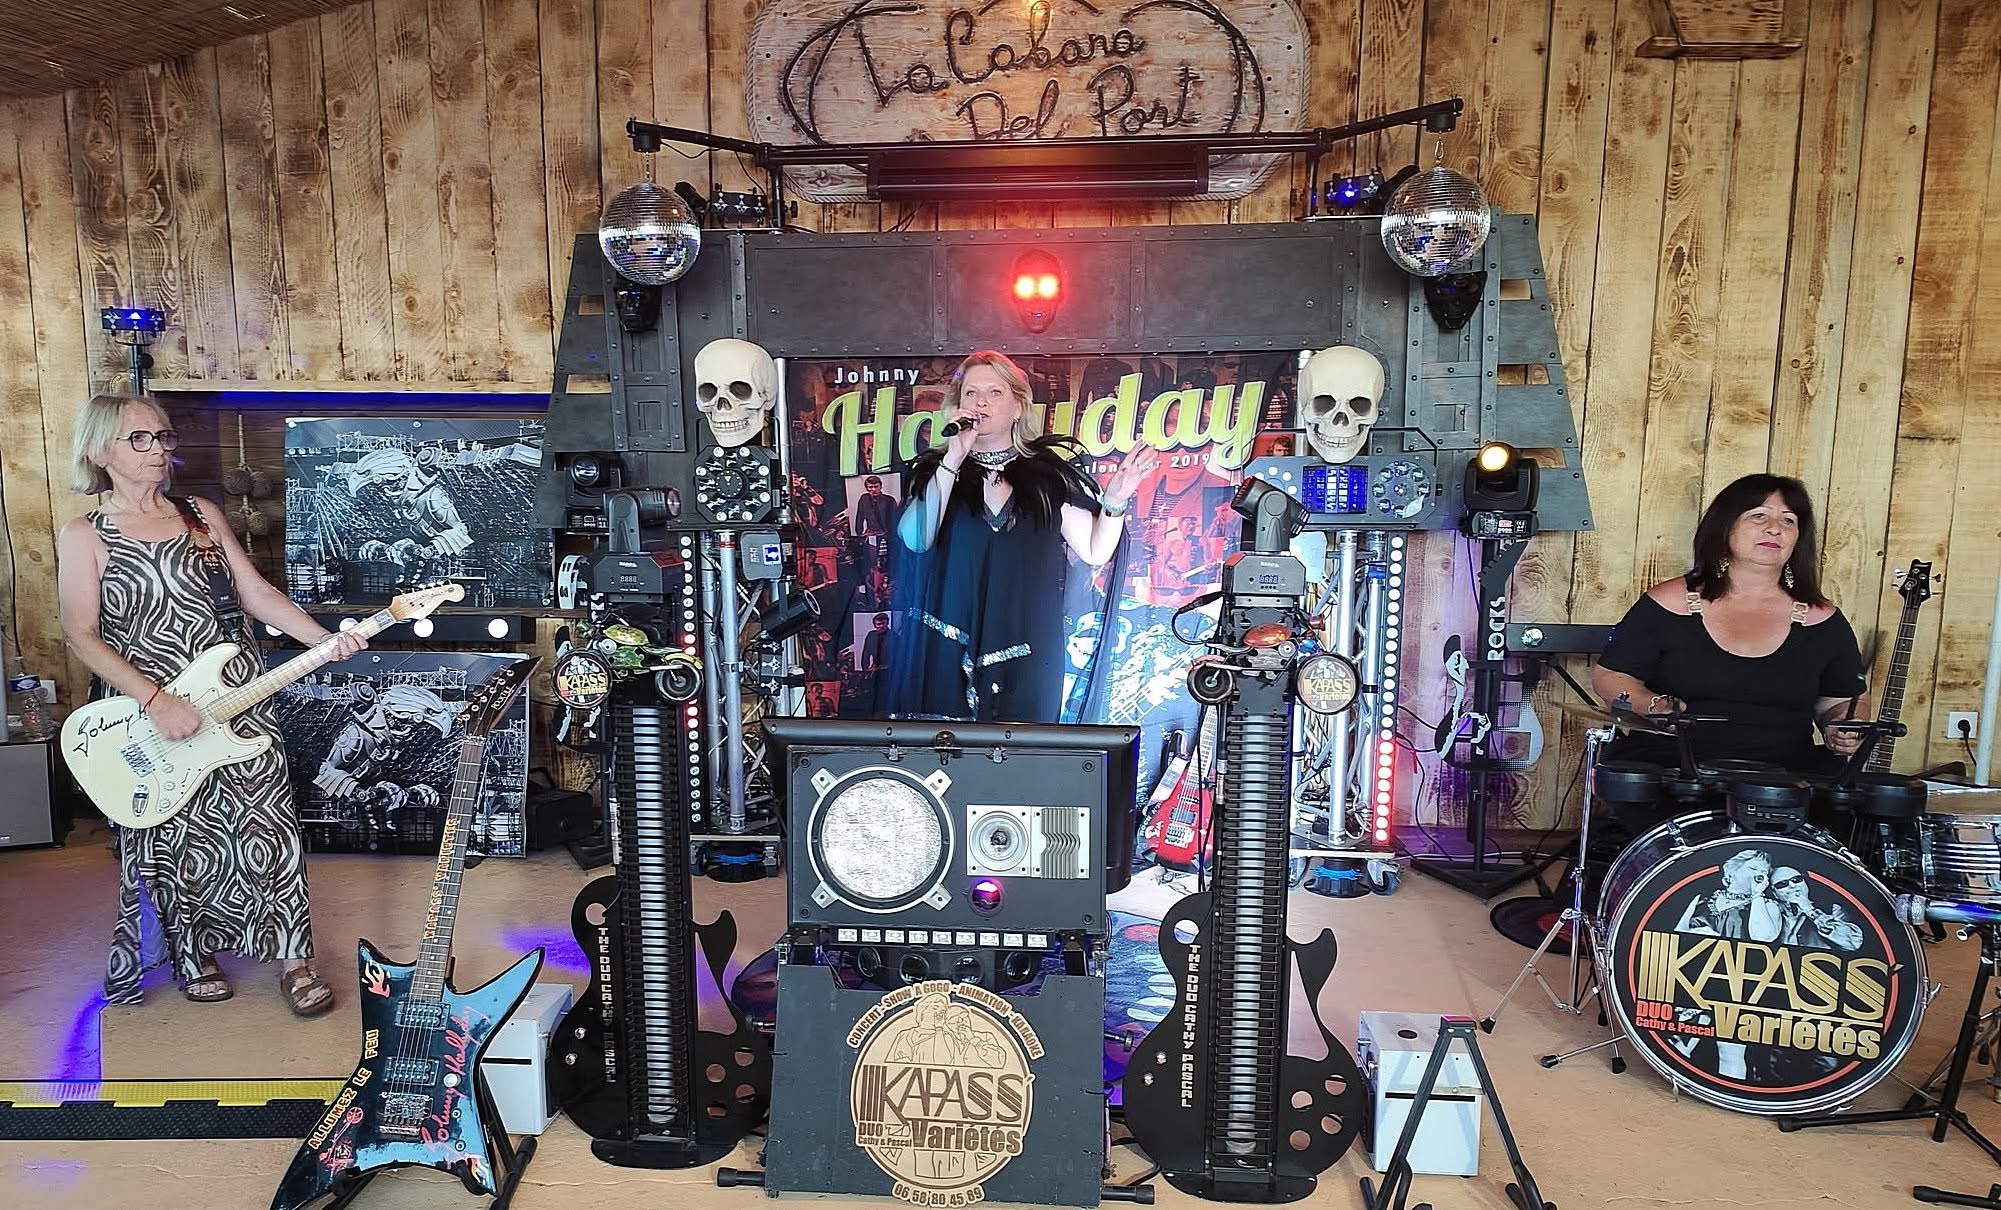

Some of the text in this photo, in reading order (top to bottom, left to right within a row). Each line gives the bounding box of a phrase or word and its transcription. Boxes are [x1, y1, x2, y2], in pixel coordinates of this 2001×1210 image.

[855, 0, 1146, 107] La Cabana
[956, 64, 1202, 139] Del Port
[834, 366, 920, 385] Johnny
[1169, 453, 1211, 468] 2019
[1487, 596, 1506, 661] ROCKS
[598, 927, 609, 953] THE
[599, 956, 611, 981] DUO
[848, 982, 1043, 1058] CONCERT SHOW A GOGO ANIMATION KARAOKE
[1636, 1000, 1673, 1021] DUO
[1181, 944, 1202, 1108] THE DUO CATHY PASCAL
[1635, 1016, 1714, 1037] Cathy & Pascal
[308, 1028, 380, 1150] ALLUMEZ LE FEU
[858, 1122, 883, 1137] DUO
[858, 1136, 879, 1146] Cathy
[887, 1137, 912, 1147] Pascal
[894, 1183, 910, 1199] 06
[931, 1192, 946, 1205] 80
[950, 1192, 964, 1206] 45
[966, 1186, 983, 1202] 89
